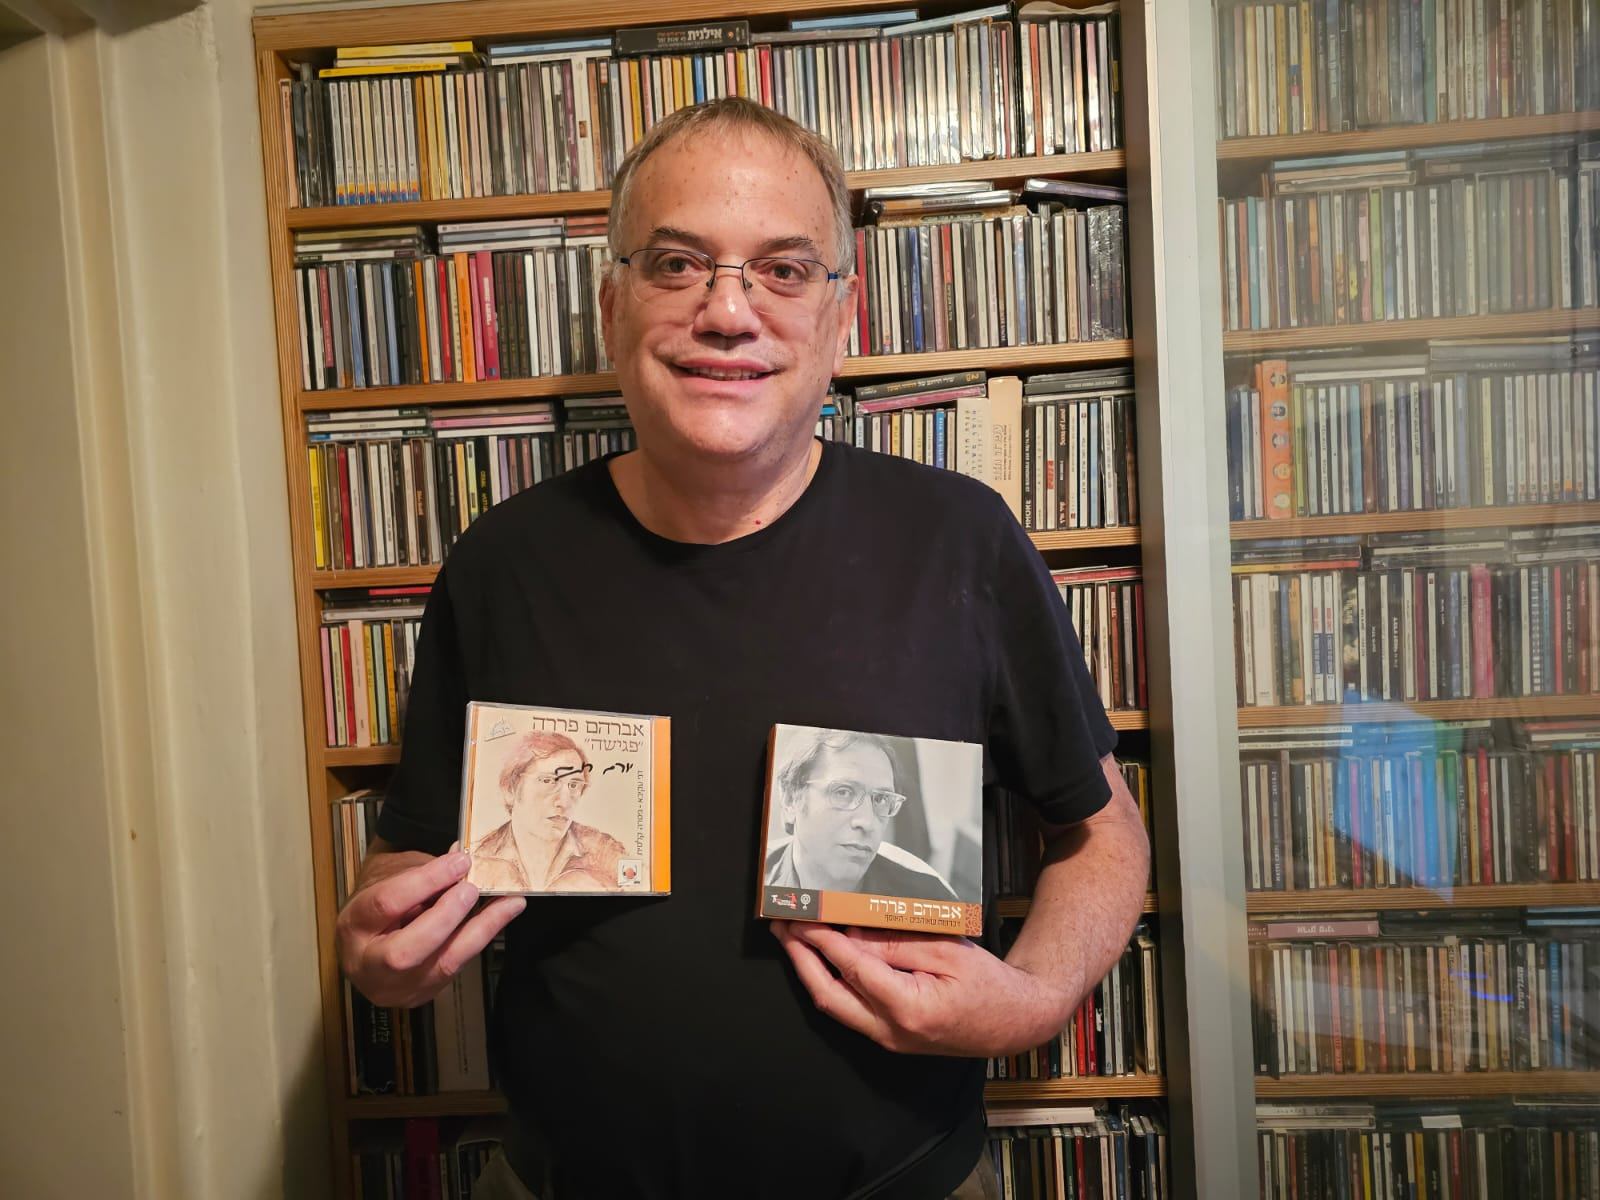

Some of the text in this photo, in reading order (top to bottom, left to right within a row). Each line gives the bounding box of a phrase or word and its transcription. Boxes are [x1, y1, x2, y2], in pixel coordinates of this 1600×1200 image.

[687, 27, 722, 41] אילנית
[532, 716, 644, 737] אברהם פררה
[869, 898, 962, 918] אברהם פררה
